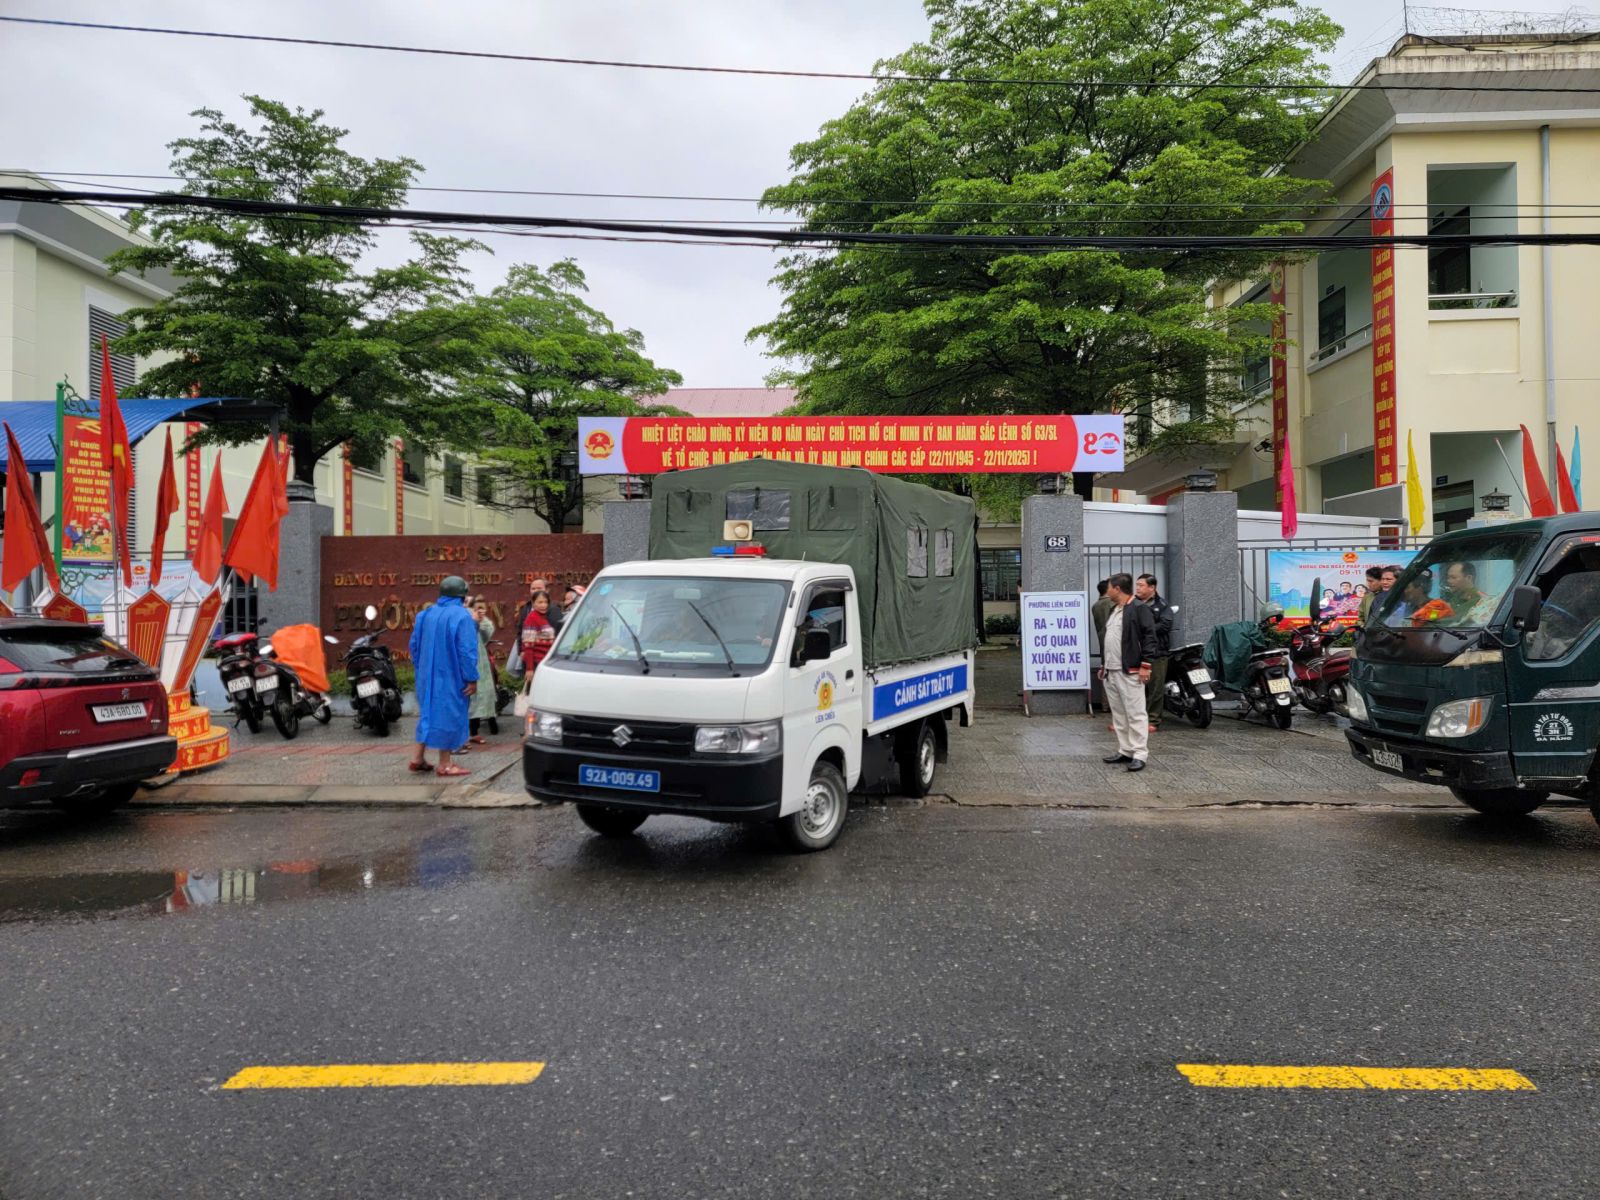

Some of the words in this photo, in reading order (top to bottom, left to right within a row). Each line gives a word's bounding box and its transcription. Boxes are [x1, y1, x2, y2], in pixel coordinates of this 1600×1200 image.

[642, 423, 664, 445] NHIỆT
[667, 423, 683, 445] LIỆT
[686, 422, 707, 442] CHÀO
[710, 422, 732, 442] MỪNG
[735, 421, 745, 442] KỶ
[749, 423, 768, 445] NIỆM
[772, 426, 782, 441] 80
[785, 423, 802, 442] NĂM
[806, 422, 826, 442] NGÀY
[829, 421, 845, 442] CHỦ
[848, 426, 866, 445] TỊCH
[883, 422, 897, 441] CHÍ
[900, 426, 920, 441] MINH
[923, 422, 934, 441] KÝ
[937, 426, 953, 441] BAN
[956, 422, 977, 441] HÀNH
[979, 420, 995, 441] SẮC
[998, 422, 1018, 444] LỆNH
[1021, 420, 1032, 441] SỐ
[1035, 425, 1058, 441] 63/SL
[662, 446, 673, 467] VỀ
[675, 445, 686, 467] TỔ
[688, 447, 709, 467] CHỨC
[822, 450, 838, 467] BAN
[841, 446, 861, 467] HÀNH
[865, 446, 888, 467] CHÍNH
[891, 446, 907, 467] CÁC
[910, 445, 926, 467] CẤP
[928, 450, 974, 466] (22/11/1945
[983, 449, 1031, 466] 22/11/2025)
[1033, 449, 1038, 465] !
[1048, 536, 1067, 547] 68
[1034, 618, 1047, 630] RA
[1056, 615, 1076, 629] VÀO
[1034, 634, 1048, 647] CƠ
[1050, 634, 1078, 648] QUAN
[1032, 648, 1066, 665] XUỐNG
[1068, 652, 1082, 664] XE
[1035, 665, 1053, 682] TẮT
[1056, 667, 1078, 682] MÁY
[894, 681, 917, 707] CẢNH
[917, 677, 930, 699] SÁT
[931, 673, 946, 697] TRẬT
[946, 671, 954, 694] TỰ
[585, 768, 654, 788] 92A-009.49
